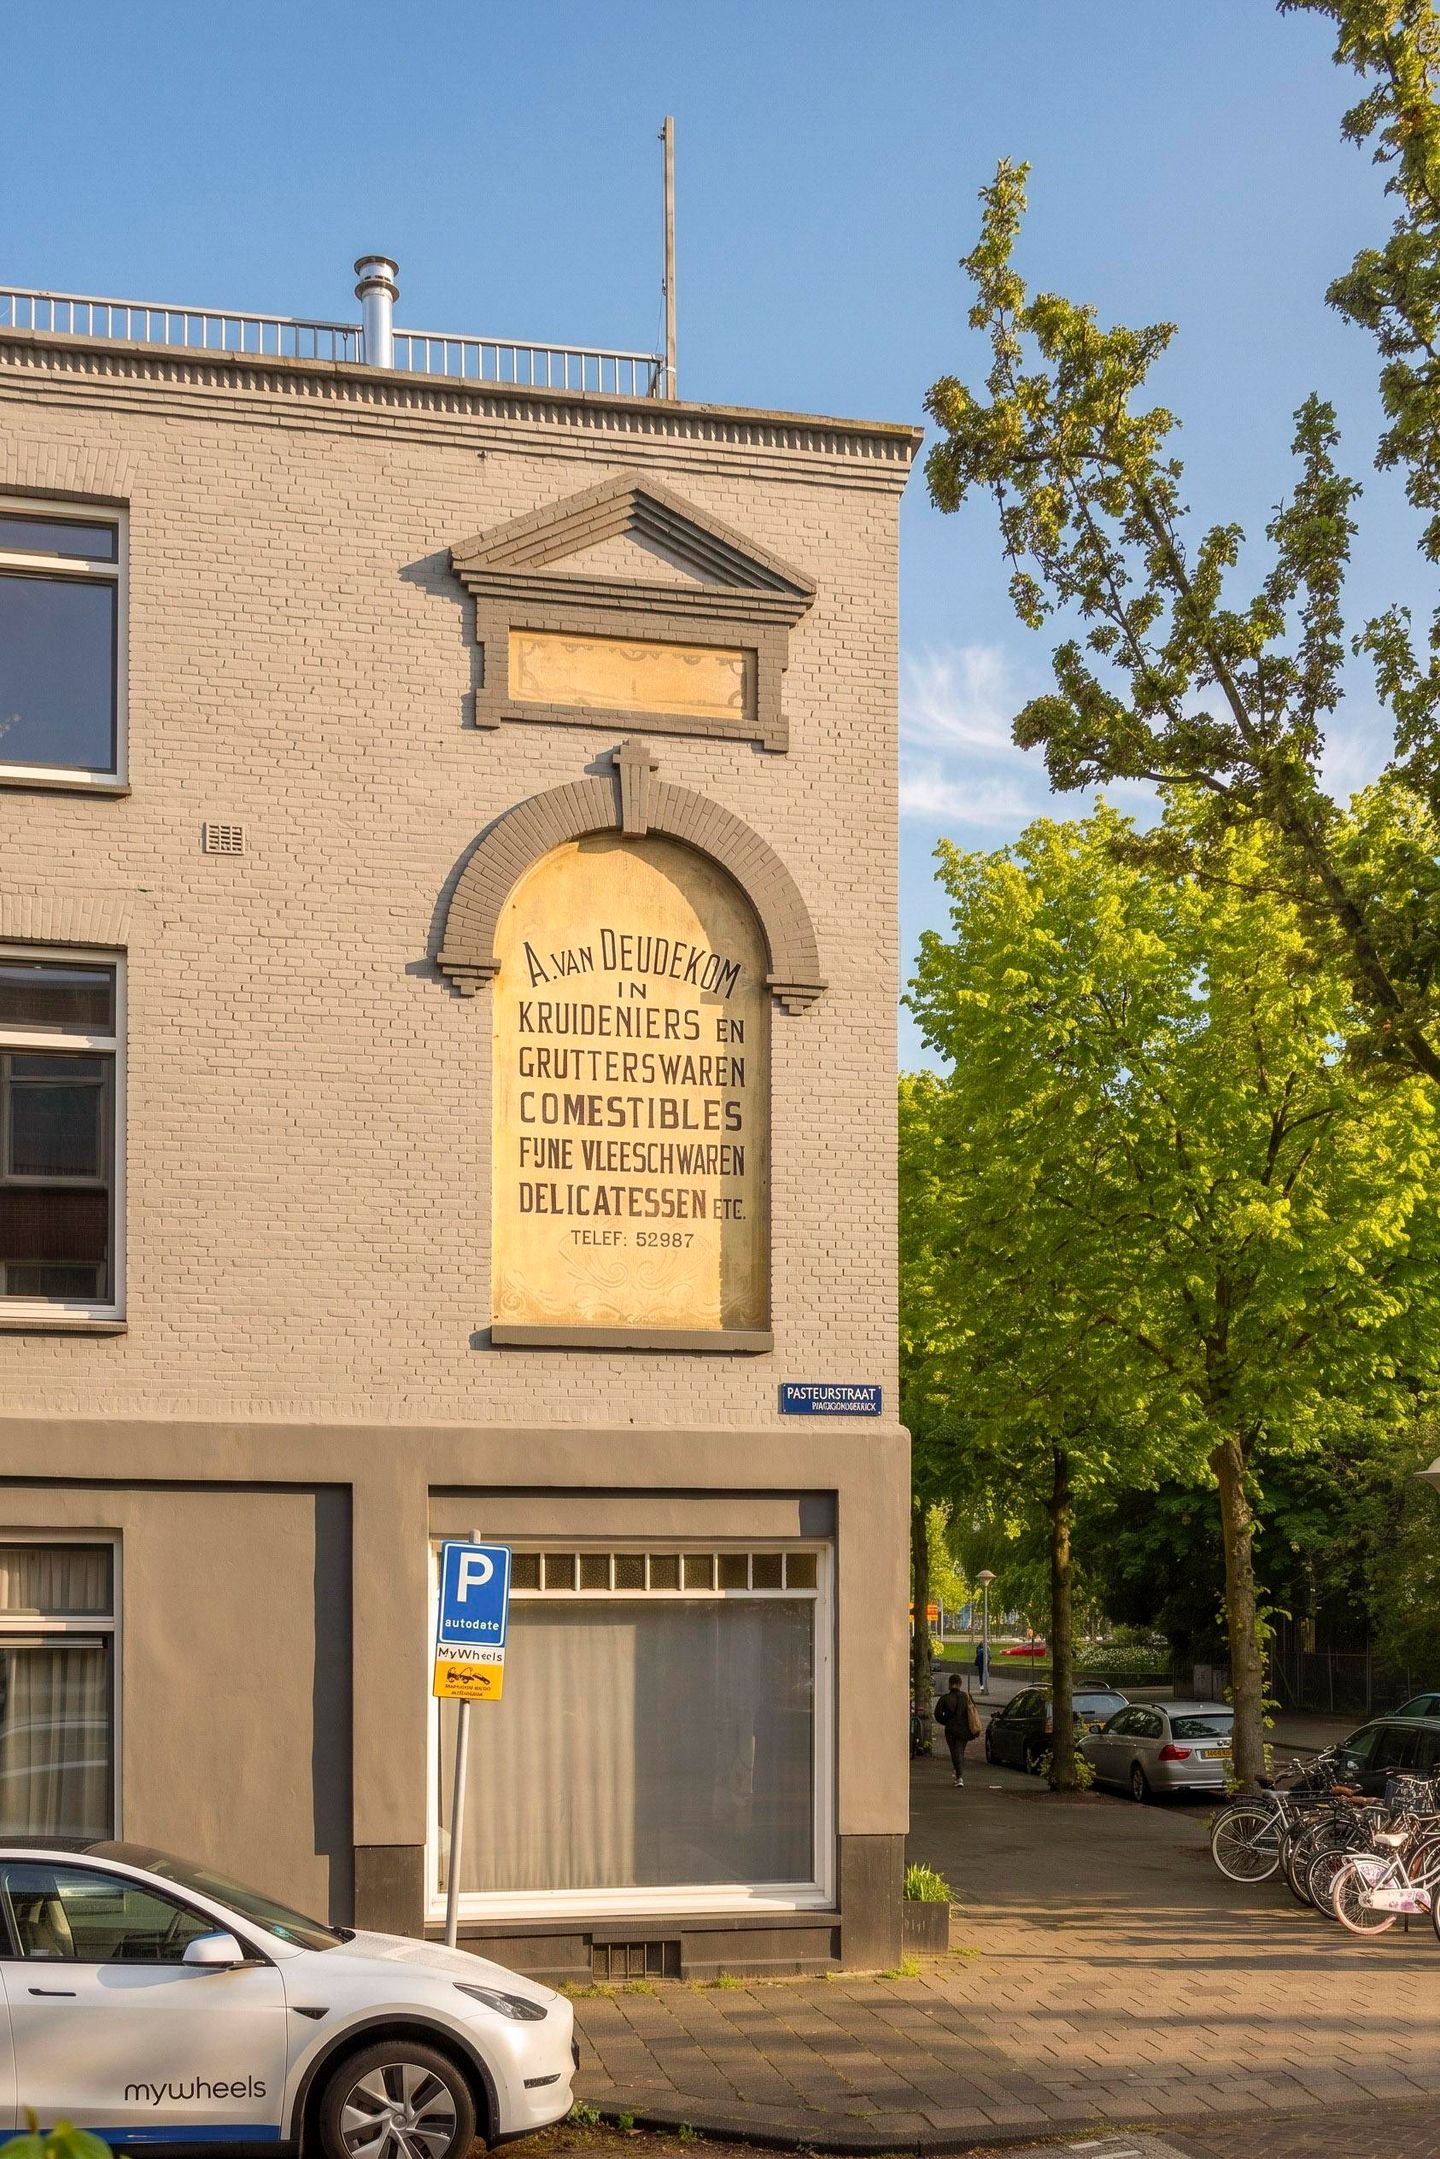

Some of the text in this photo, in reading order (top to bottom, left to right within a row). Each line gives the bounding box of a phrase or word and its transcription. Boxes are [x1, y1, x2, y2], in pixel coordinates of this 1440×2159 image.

[600, 929, 742, 999] DEUDEKOM
[619, 982, 647, 999] IN
[519, 1001, 745, 1044] KRUIDENIERS EN
[518, 1046, 746, 1088] GRUTTERSWAREN
[520, 1091, 743, 1131] COMESTIBLES
[581, 1139, 746, 1177] VLEESCHWAREN
[518, 1182, 747, 1221] DELICATESSEN ETC.
[570, 1229, 695, 1249] TELEF: 52987
[787, 1387, 876, 1400] PASTEURSTRAAT
[457, 1552, 494, 1603] P
[445, 1618, 499, 1631] autodate
[438, 1647, 503, 1662] MyWheels
[124, 2075, 267, 2106] mywheels
